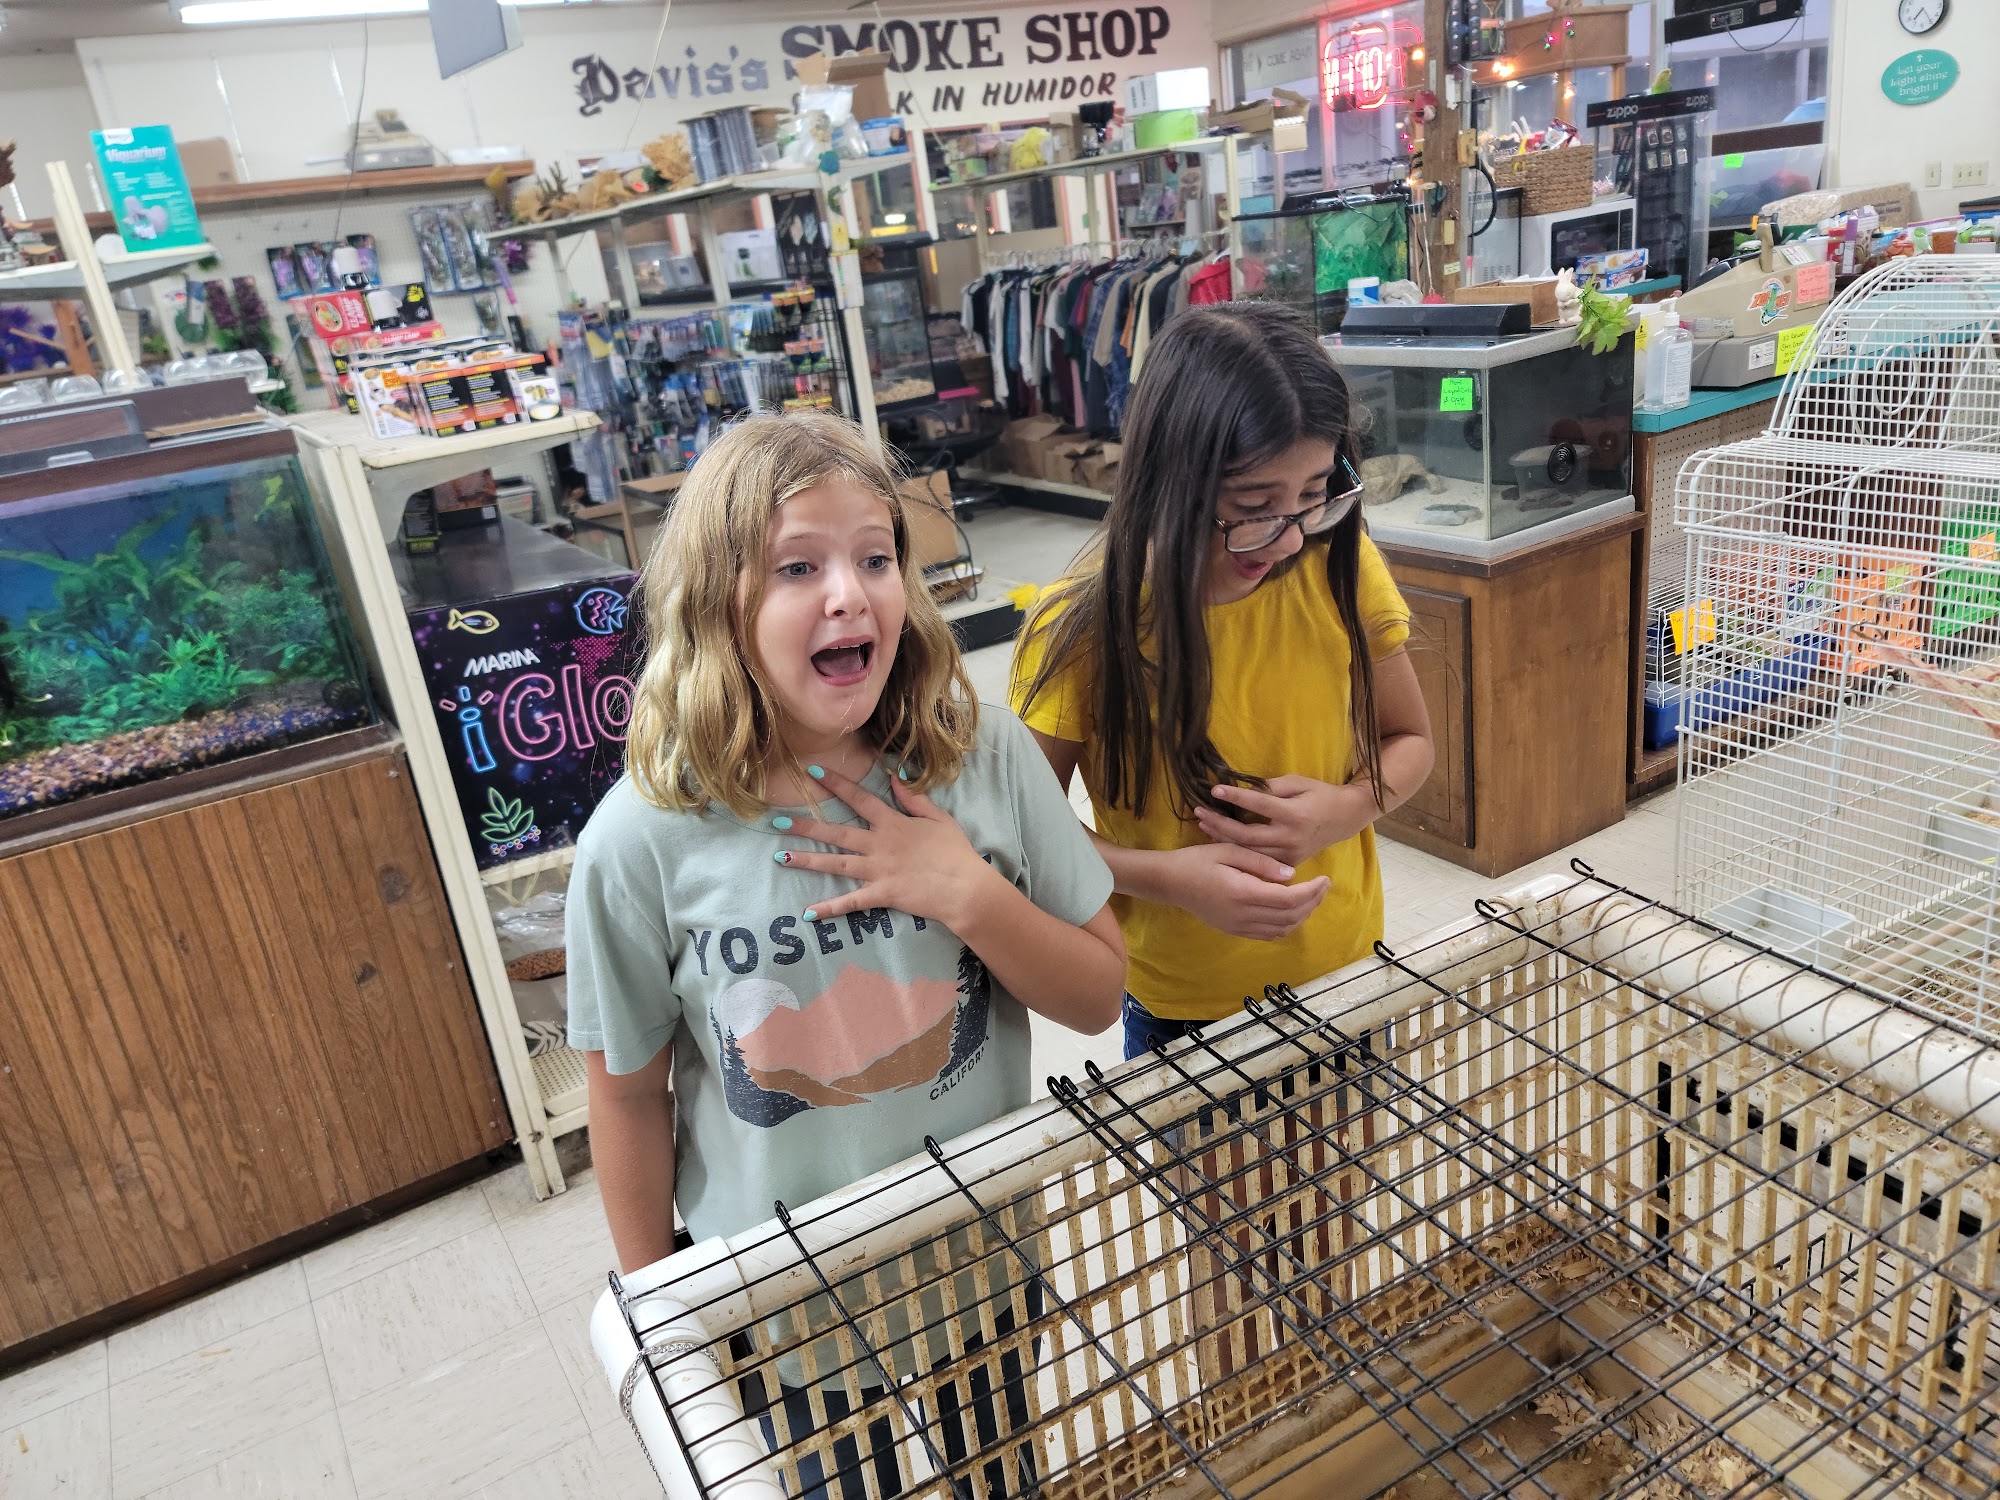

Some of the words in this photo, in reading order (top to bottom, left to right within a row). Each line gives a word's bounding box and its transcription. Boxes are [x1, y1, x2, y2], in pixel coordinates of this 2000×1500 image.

[572, 45, 769, 117] Davis's
[1025, 6, 1170, 65] SHOP
[932, 85, 965, 112] IN
[982, 72, 1117, 107] HUMIDOR
[464, 647, 541, 677] MARINA
